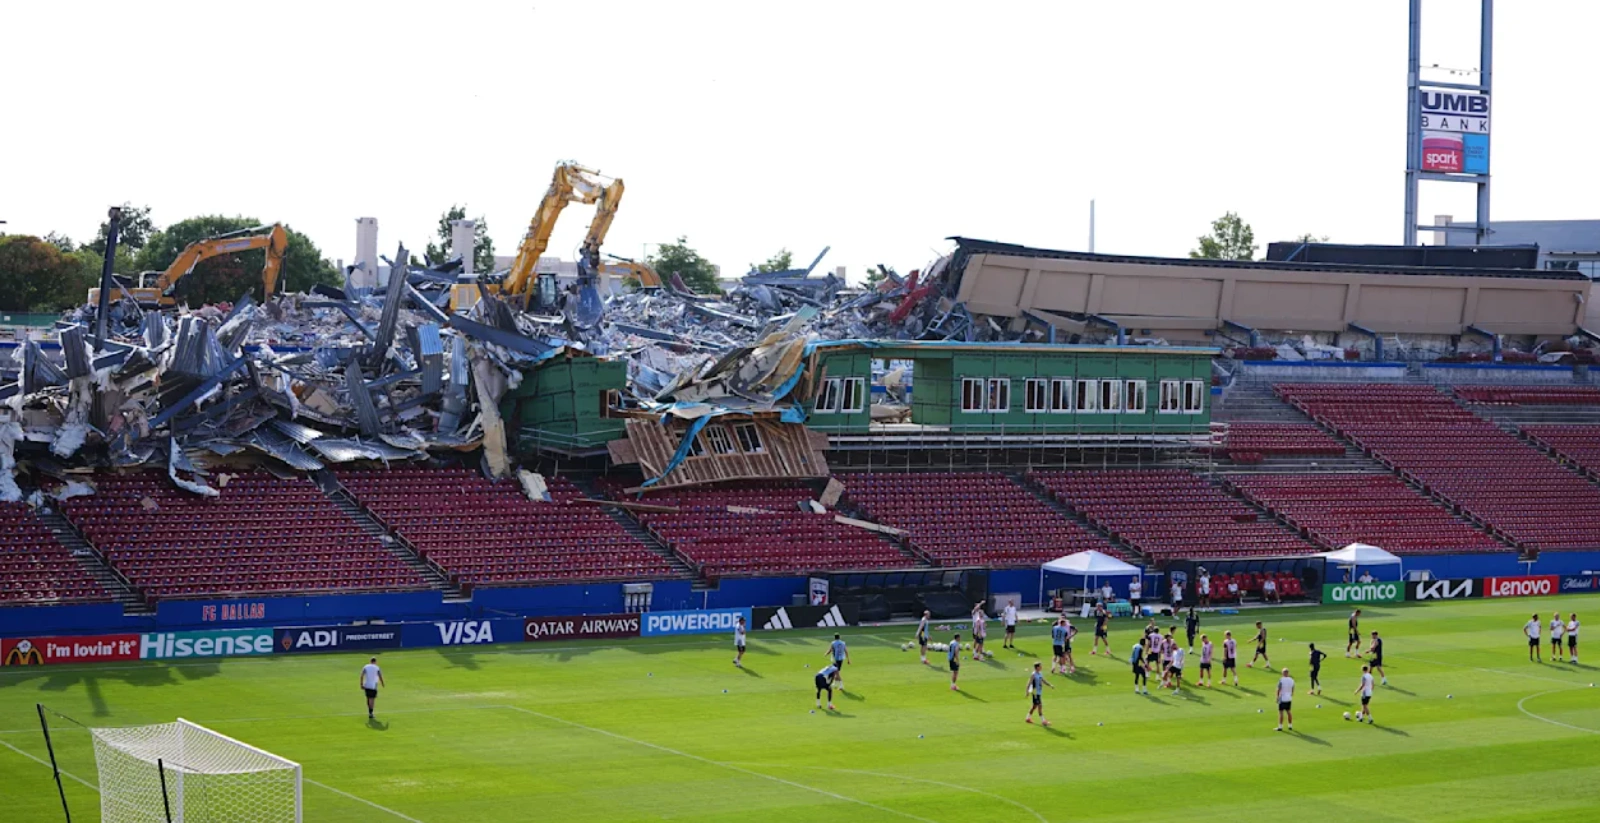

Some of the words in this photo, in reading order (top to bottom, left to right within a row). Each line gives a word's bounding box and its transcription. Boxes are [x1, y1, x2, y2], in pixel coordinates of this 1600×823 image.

[1421, 92, 1488, 113] UMB
[1421, 116, 1487, 132] BANK
[1426, 151, 1458, 167] spark
[1332, 583, 1396, 601] aramco
[1491, 578, 1551, 596] Lenovo
[202, 605, 216, 621] FC
[221, 603, 265, 620] DALLAS
[526, 620, 574, 638] QATAR
[580, 618, 639, 634] AIRWAYS
[648, 612, 743, 632] POWERADE
[295, 630, 338, 648] ADI
[434, 621, 493, 645] VISA
[47, 643, 71, 658] i'm
[74, 641, 116, 657] lovin'
[139, 633, 273, 659] Hisense
